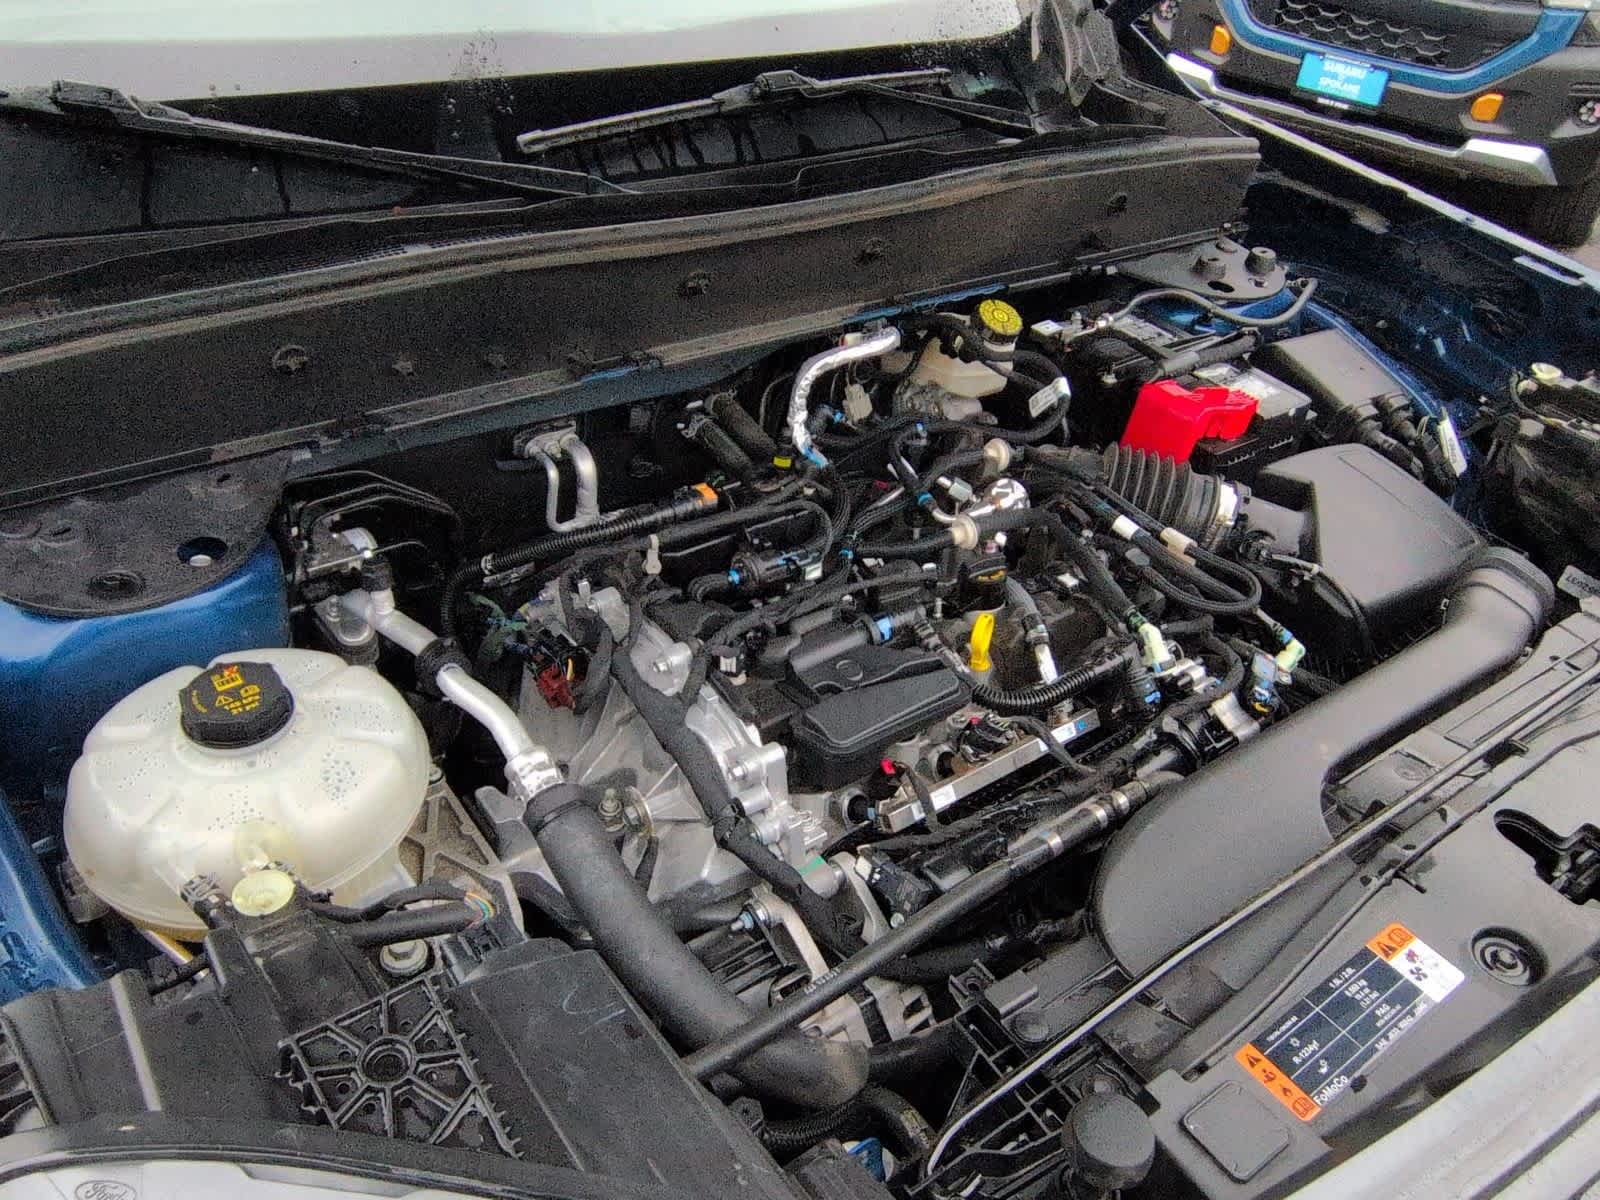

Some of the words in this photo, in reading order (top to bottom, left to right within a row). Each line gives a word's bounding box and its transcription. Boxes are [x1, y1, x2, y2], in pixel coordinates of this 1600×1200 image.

[1292, 1040, 1320, 1064] R-1234yf
[1313, 1075, 1349, 1106] FoMoCo
[85, 1183, 130, 1200] Ford
